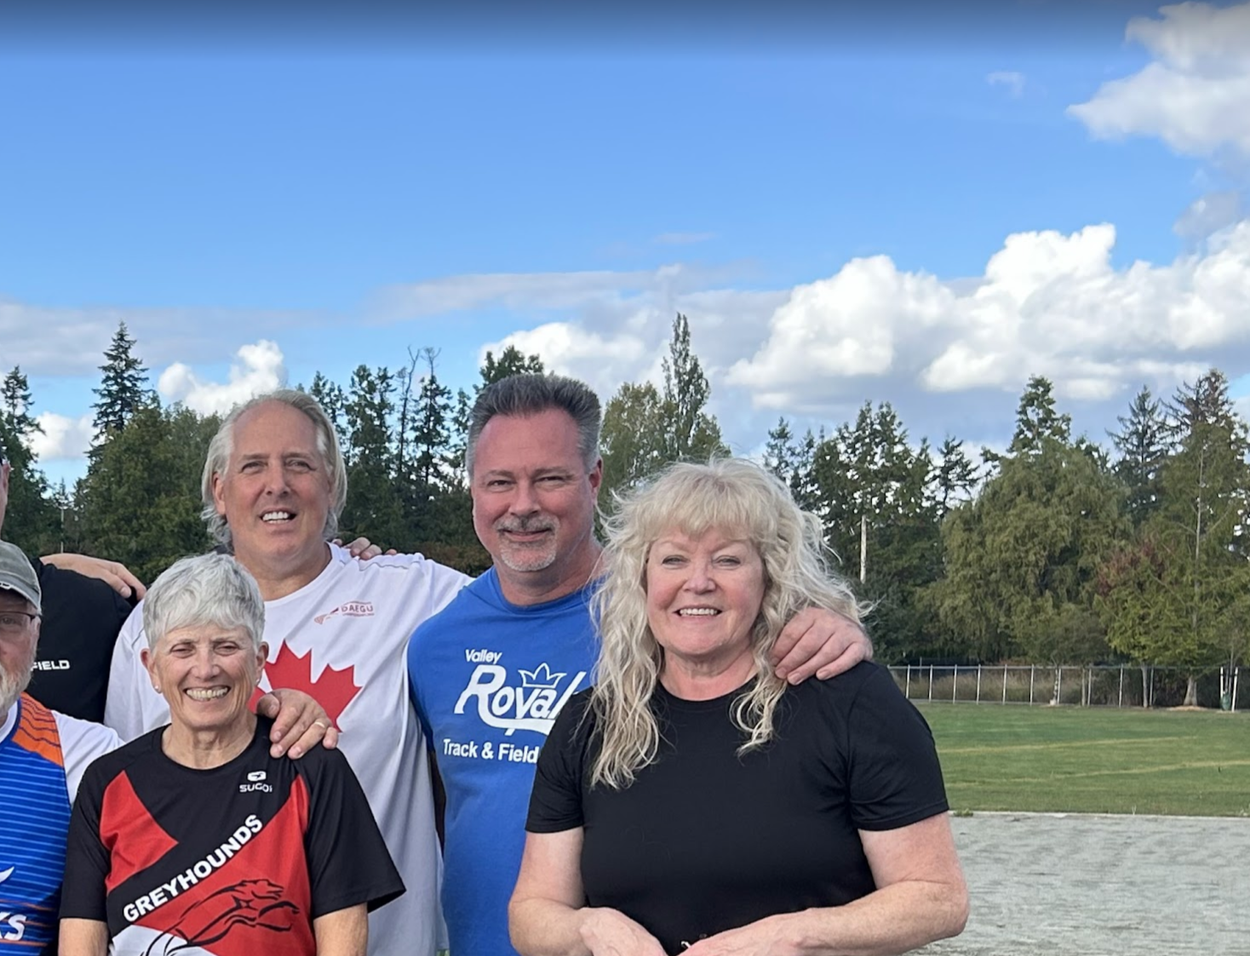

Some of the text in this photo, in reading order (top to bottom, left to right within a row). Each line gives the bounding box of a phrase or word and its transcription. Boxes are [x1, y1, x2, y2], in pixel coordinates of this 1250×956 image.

[341, 604, 374, 613] DAEGU
[465, 649, 502, 664] Valley
[453, 664, 587, 736] Royal
[443, 739, 540, 763] Track & Field
[239, 782, 273, 793] SUGOI
[123, 814, 263, 922] GREYHOUNDS
